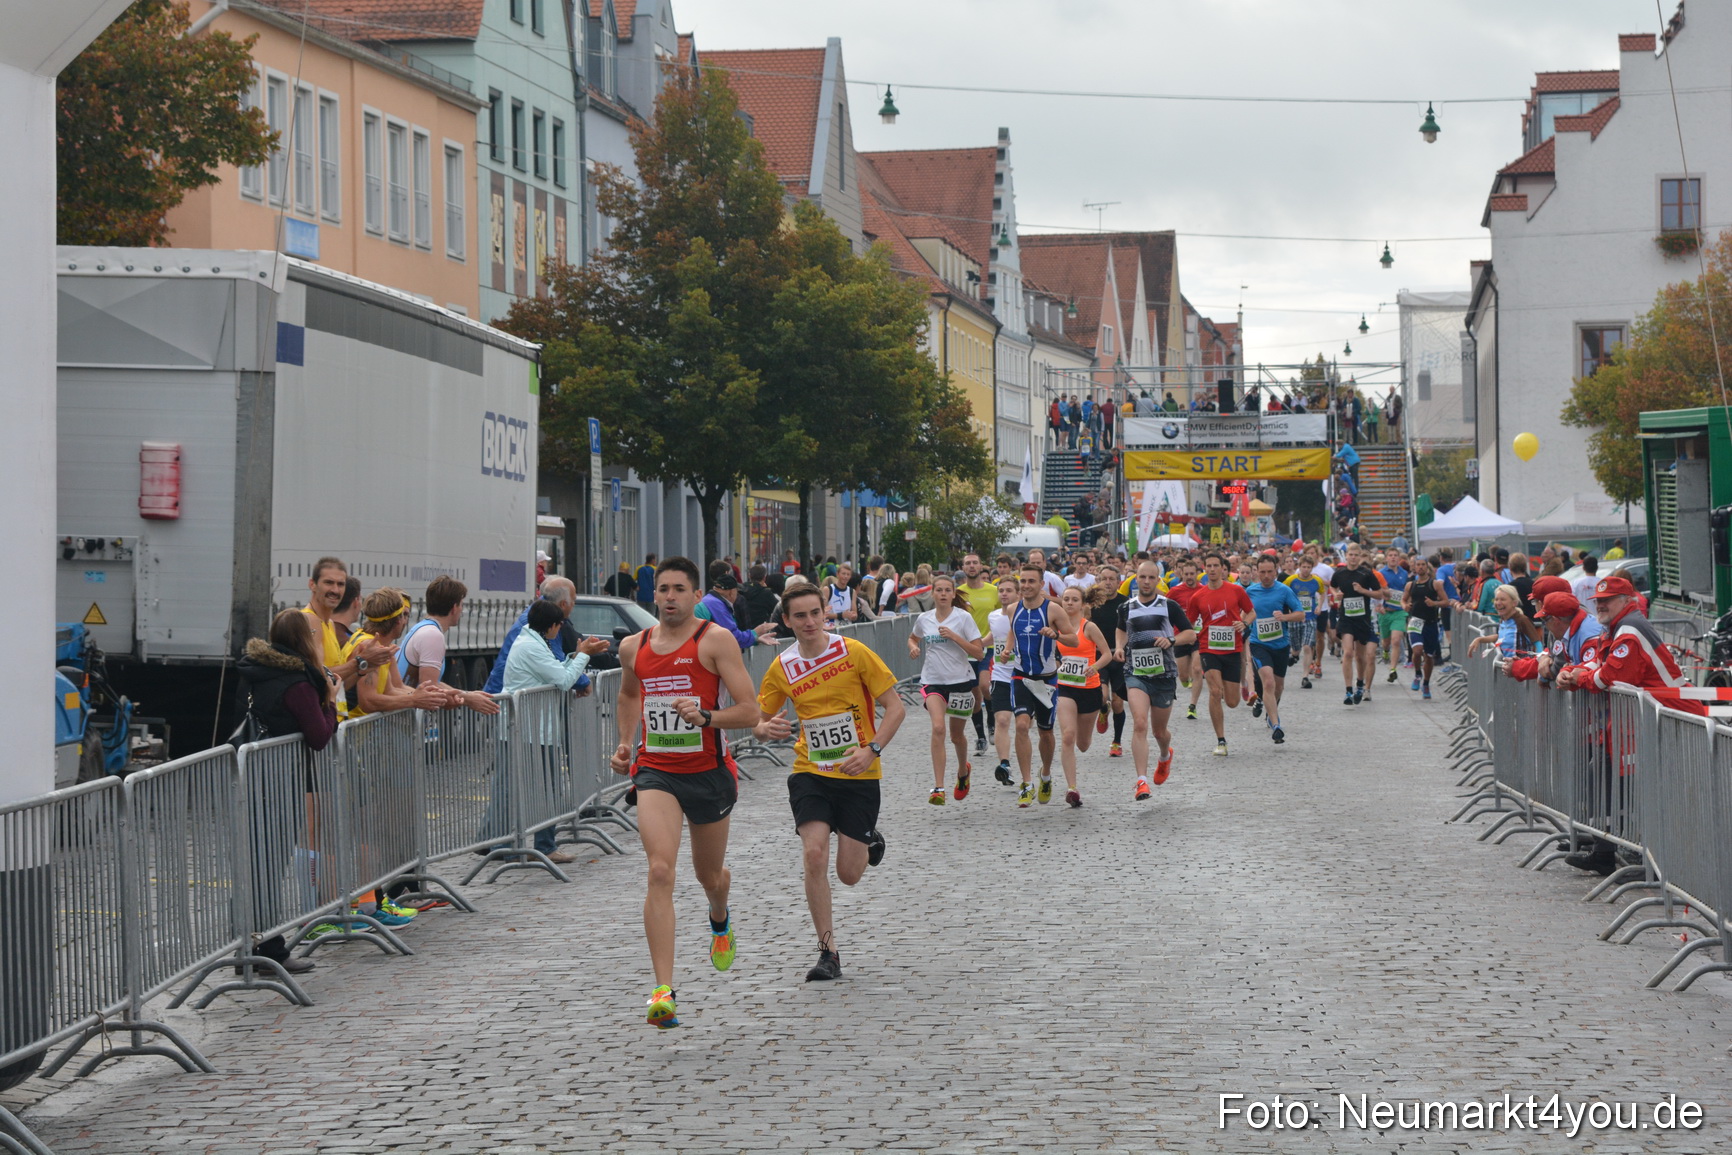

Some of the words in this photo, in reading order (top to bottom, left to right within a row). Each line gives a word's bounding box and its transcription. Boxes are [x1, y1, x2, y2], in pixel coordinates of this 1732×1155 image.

[1183, 423, 1207, 431] BMW
[481, 411, 528, 482] BOCK
[1191, 455, 1263, 473] START
[1258, 621, 1280, 633] 5078
[1210, 631, 1233, 641] 5085
[1134, 654, 1161, 668] 5066
[641, 674, 693, 693] ESB
[791, 677, 820, 698] MAX
[821, 660, 855, 682] BÖGL
[658, 736, 685, 746] Florian
[809, 724, 853, 749] 5155
[820, 748, 847, 760] Matthia
